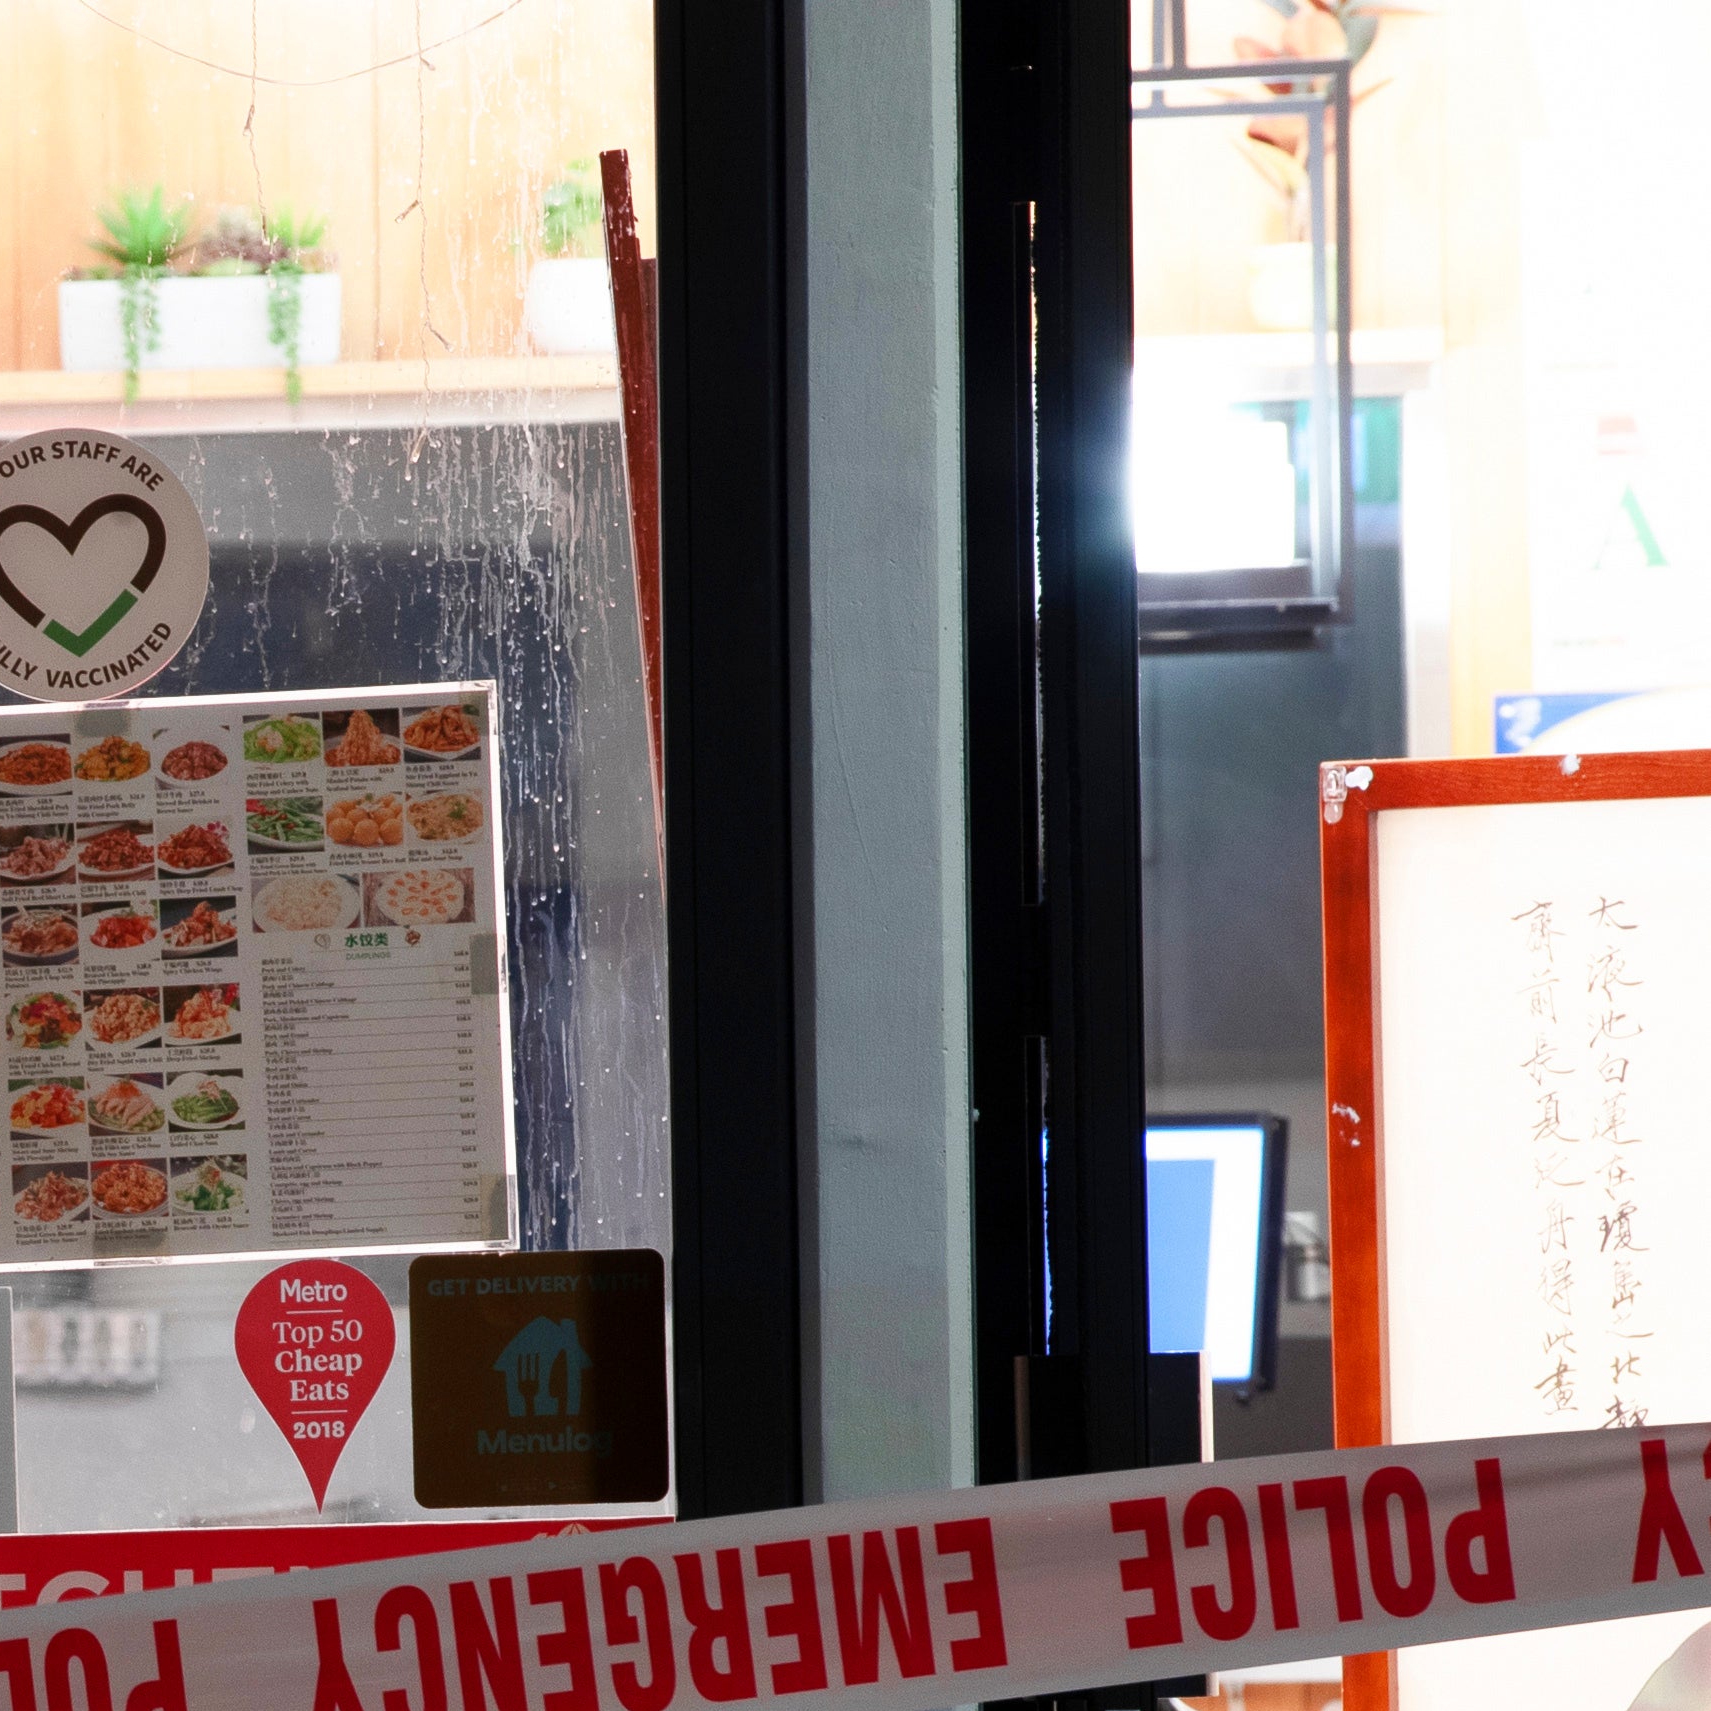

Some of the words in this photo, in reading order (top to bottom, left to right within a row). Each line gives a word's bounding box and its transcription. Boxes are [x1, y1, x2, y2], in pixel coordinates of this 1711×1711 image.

[51, 440, 121, 463] STAFF
[120, 455, 164, 492] ARE
[45, 622, 172, 688] VACCINATED
[280, 1278, 348, 1303] Metro
[427, 1279, 470, 1297] GET
[475, 1275, 581, 1296] DELIVERY
[587, 1273, 650, 1292] WITH
[272, 1321, 323, 1349] Top
[330, 1318, 363, 1342] 50
[275, 1351, 363, 1377] Cheap
[289, 1378, 350, 1402] Eats
[293, 1420, 345, 1440] 2018
[477, 1426, 612, 1458] Menulog
[1111, 1459, 1515, 1648] POLICE
